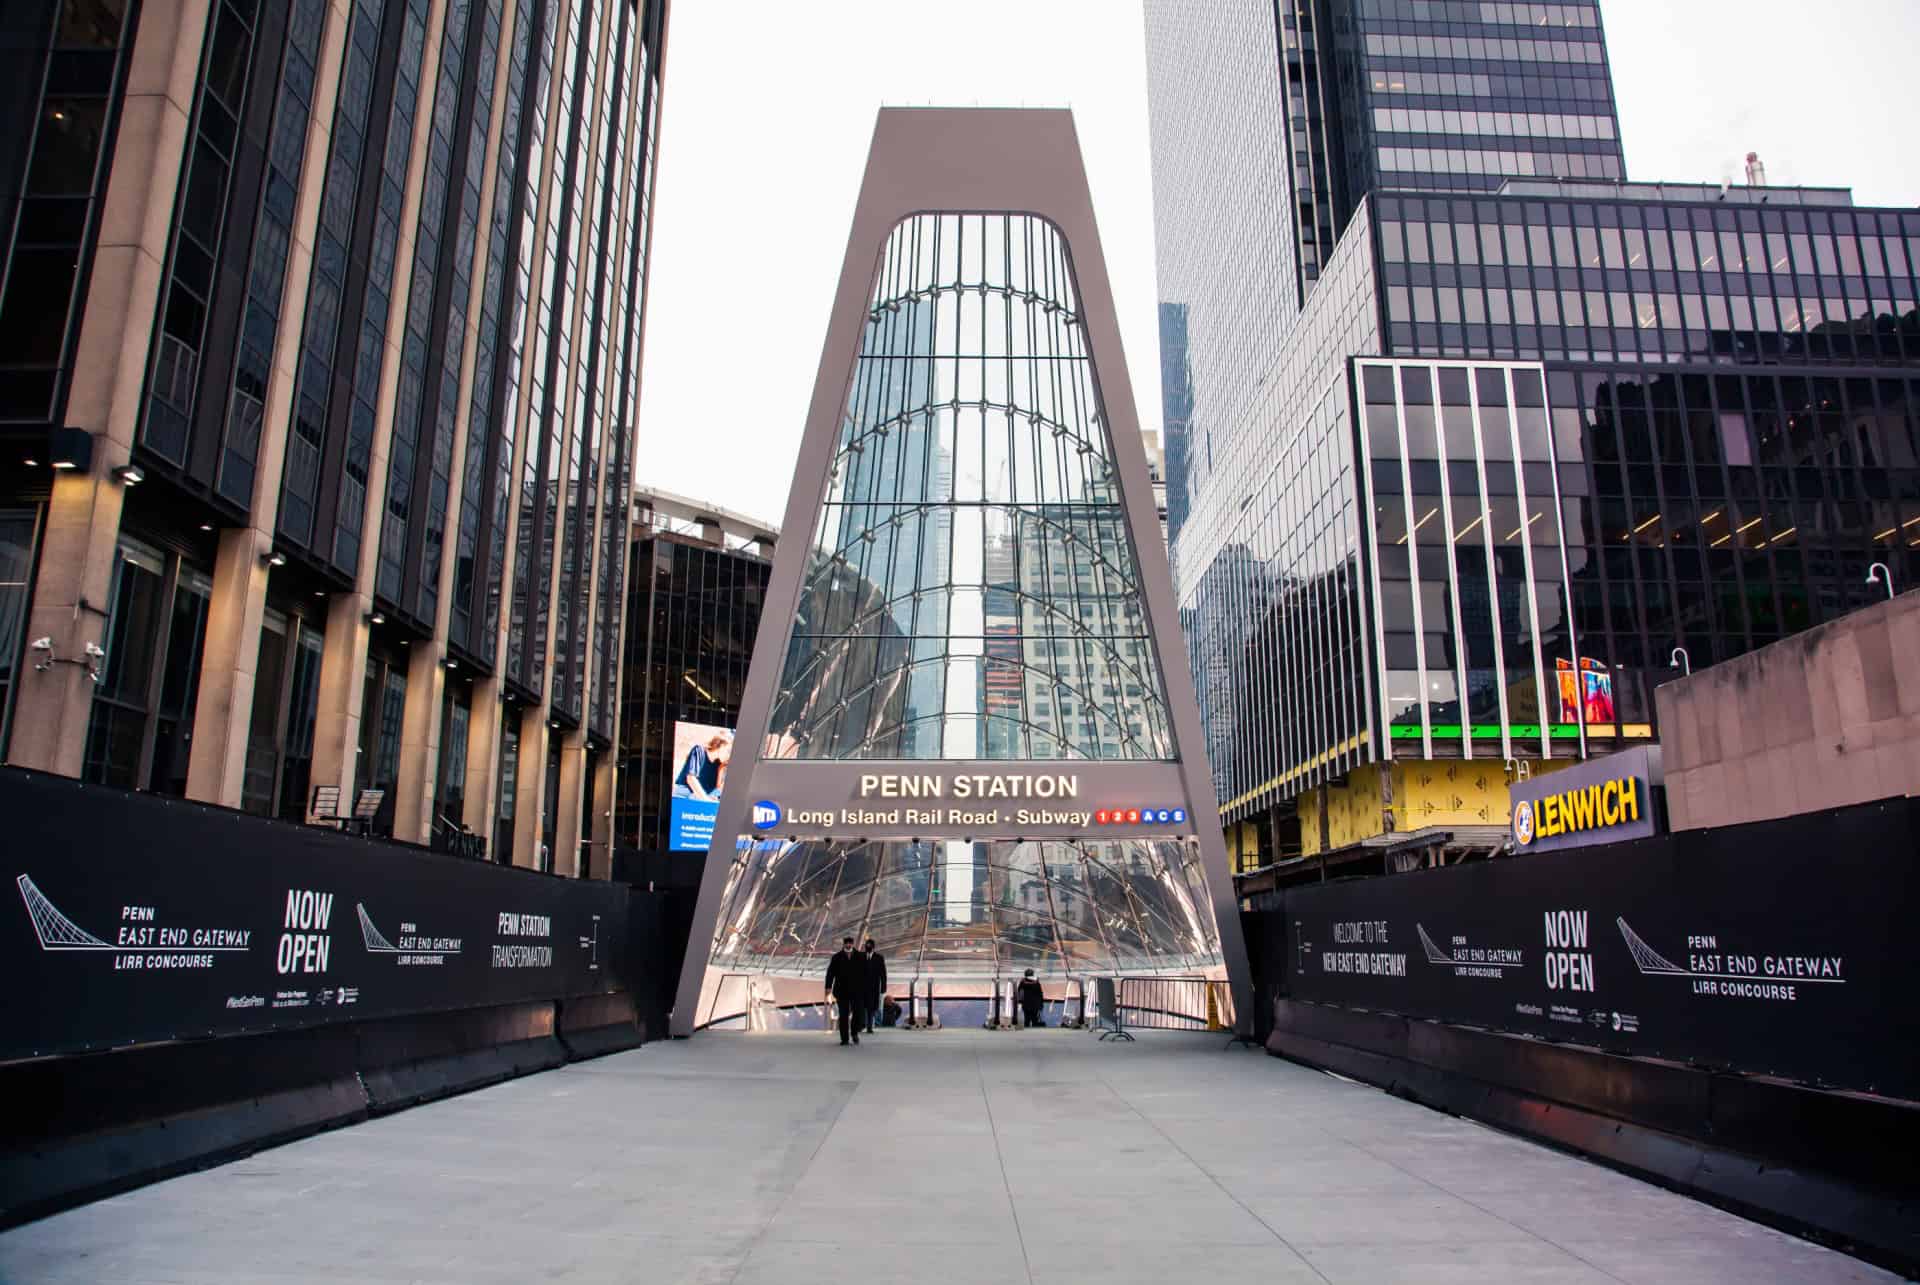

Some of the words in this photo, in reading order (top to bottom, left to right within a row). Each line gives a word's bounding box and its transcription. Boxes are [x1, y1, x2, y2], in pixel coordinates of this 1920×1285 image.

[860, 775, 942, 797] PENN
[952, 775, 1078, 797] STATION
[753, 806, 777, 824] MTA
[1533, 775, 1638, 839] LENWICH
[787, 808, 834, 827] Long
[841, 809, 898, 824] Island
[906, 809, 942, 824] Rail
[949, 809, 997, 824] Road
[1017, 809, 1091, 827] Subway
[121, 906, 155, 921] PENN
[284, 889, 334, 930] NOW
[400, 923, 416, 933] PENN
[498, 912, 520, 935] PENN
[520, 914, 550, 937] STATION
[1333, 922, 1364, 943] WELCOME
[1365, 922, 1374, 943] TO
[1374, 921, 1388, 943] THE
[1545, 911, 1587, 948] NOW
[118, 927, 156, 945] EAST
[159, 928, 188, 945] END
[192, 929, 251, 946] GATEWAY
[400, 936, 416, 949] EAST
[418, 937, 432, 949] END
[434, 938, 461, 950] GATEWAY
[1452, 936, 1466, 944] PENN
[1688, 936, 1716, 949] PENN
[114, 955, 143, 969] LIRR
[146, 954, 214, 969] CONCOURSE
[277, 933, 330, 974] OPEN
[412, 955, 444, 965] CONCOURSE
[492, 945, 552, 968] TRANSFORMATION
[1453, 949, 1468, 961] EAST
[1471, 949, 1485, 961] END
[1487, 950, 1522, 963] GATEWAY
[1323, 952, 1337, 972] NEW
[1338, 952, 1354, 973] EAST
[1355, 953, 1369, 974] END
[1371, 953, 1407, 977] GATEWAY
[1468, 968, 1502, 978] CONCOURSE
[1545, 952, 1594, 992] OPEN
[1690, 955, 1722, 972] EAST
[1727, 956, 1757, 974] END
[1764, 957, 1841, 977] GATEWAY
[1693, 980, 1718, 995] LIRR
[1720, 982, 1796, 1000] CONCOURSE
